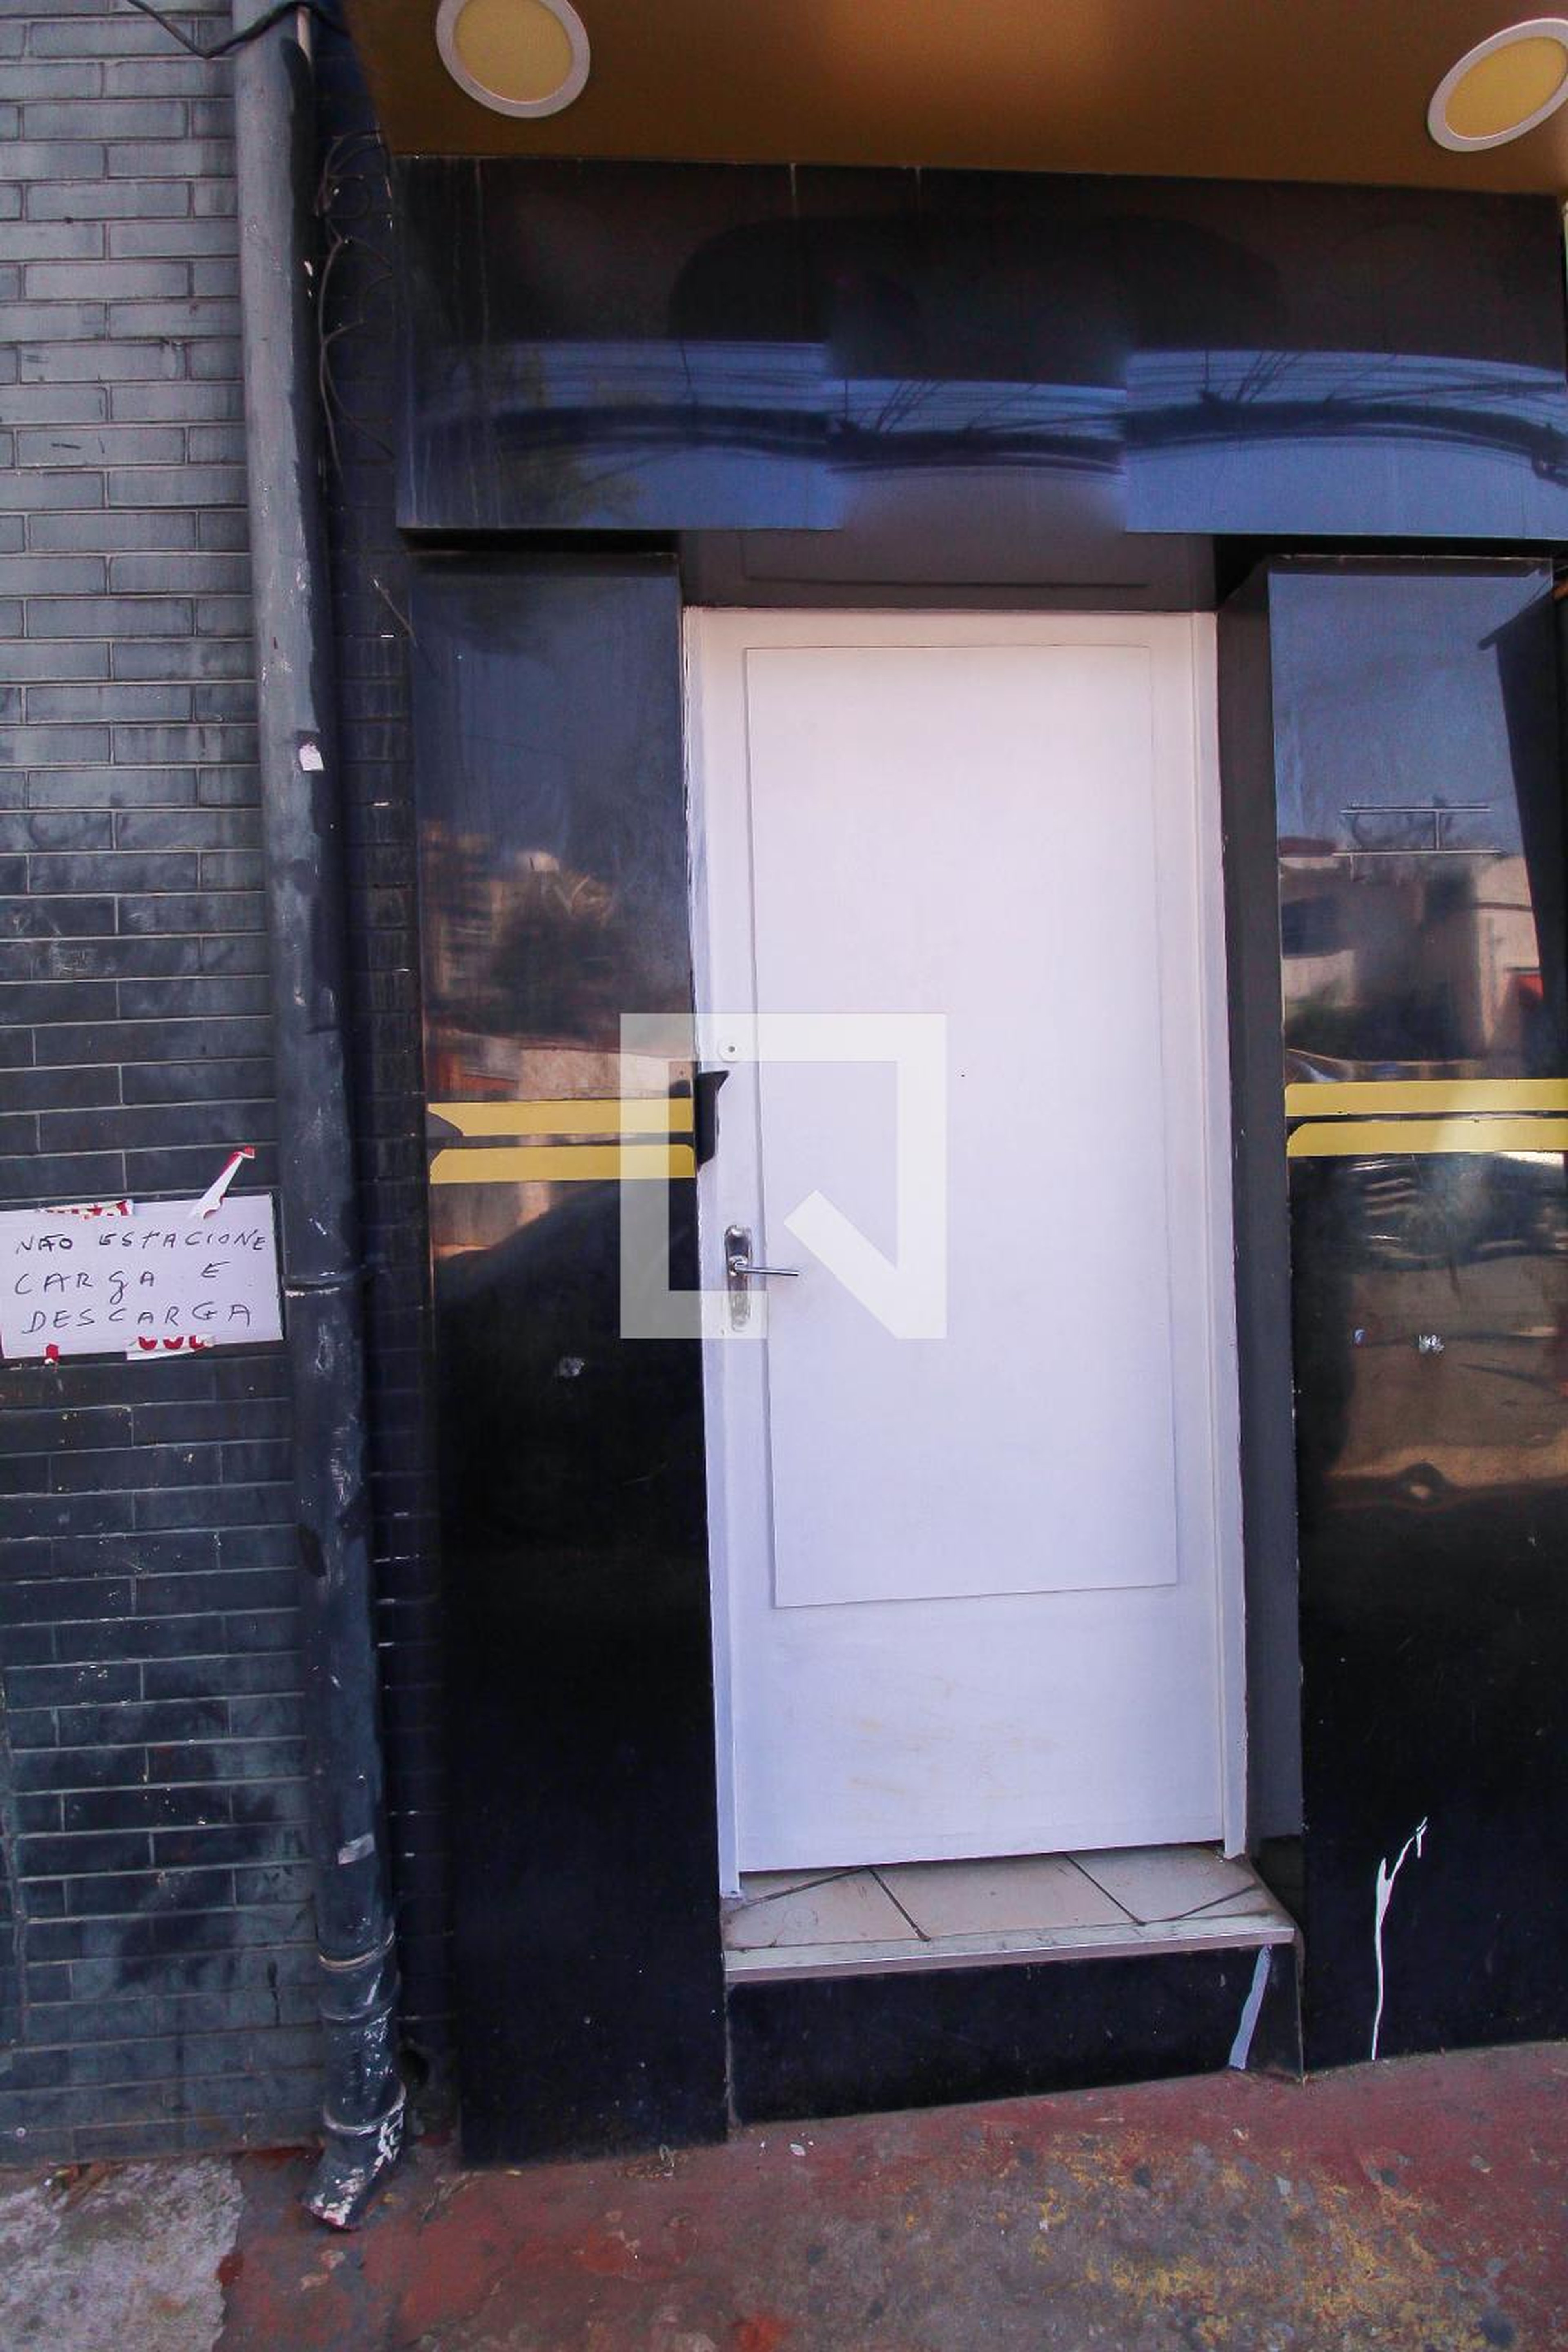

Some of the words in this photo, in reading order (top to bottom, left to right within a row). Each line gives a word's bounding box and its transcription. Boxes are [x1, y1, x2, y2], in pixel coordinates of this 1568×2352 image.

[99, 1229, 267, 1250] ESTACIONE
[201, 1261, 230, 1278] E
[22, 1301, 250, 1334] DESCARGA
